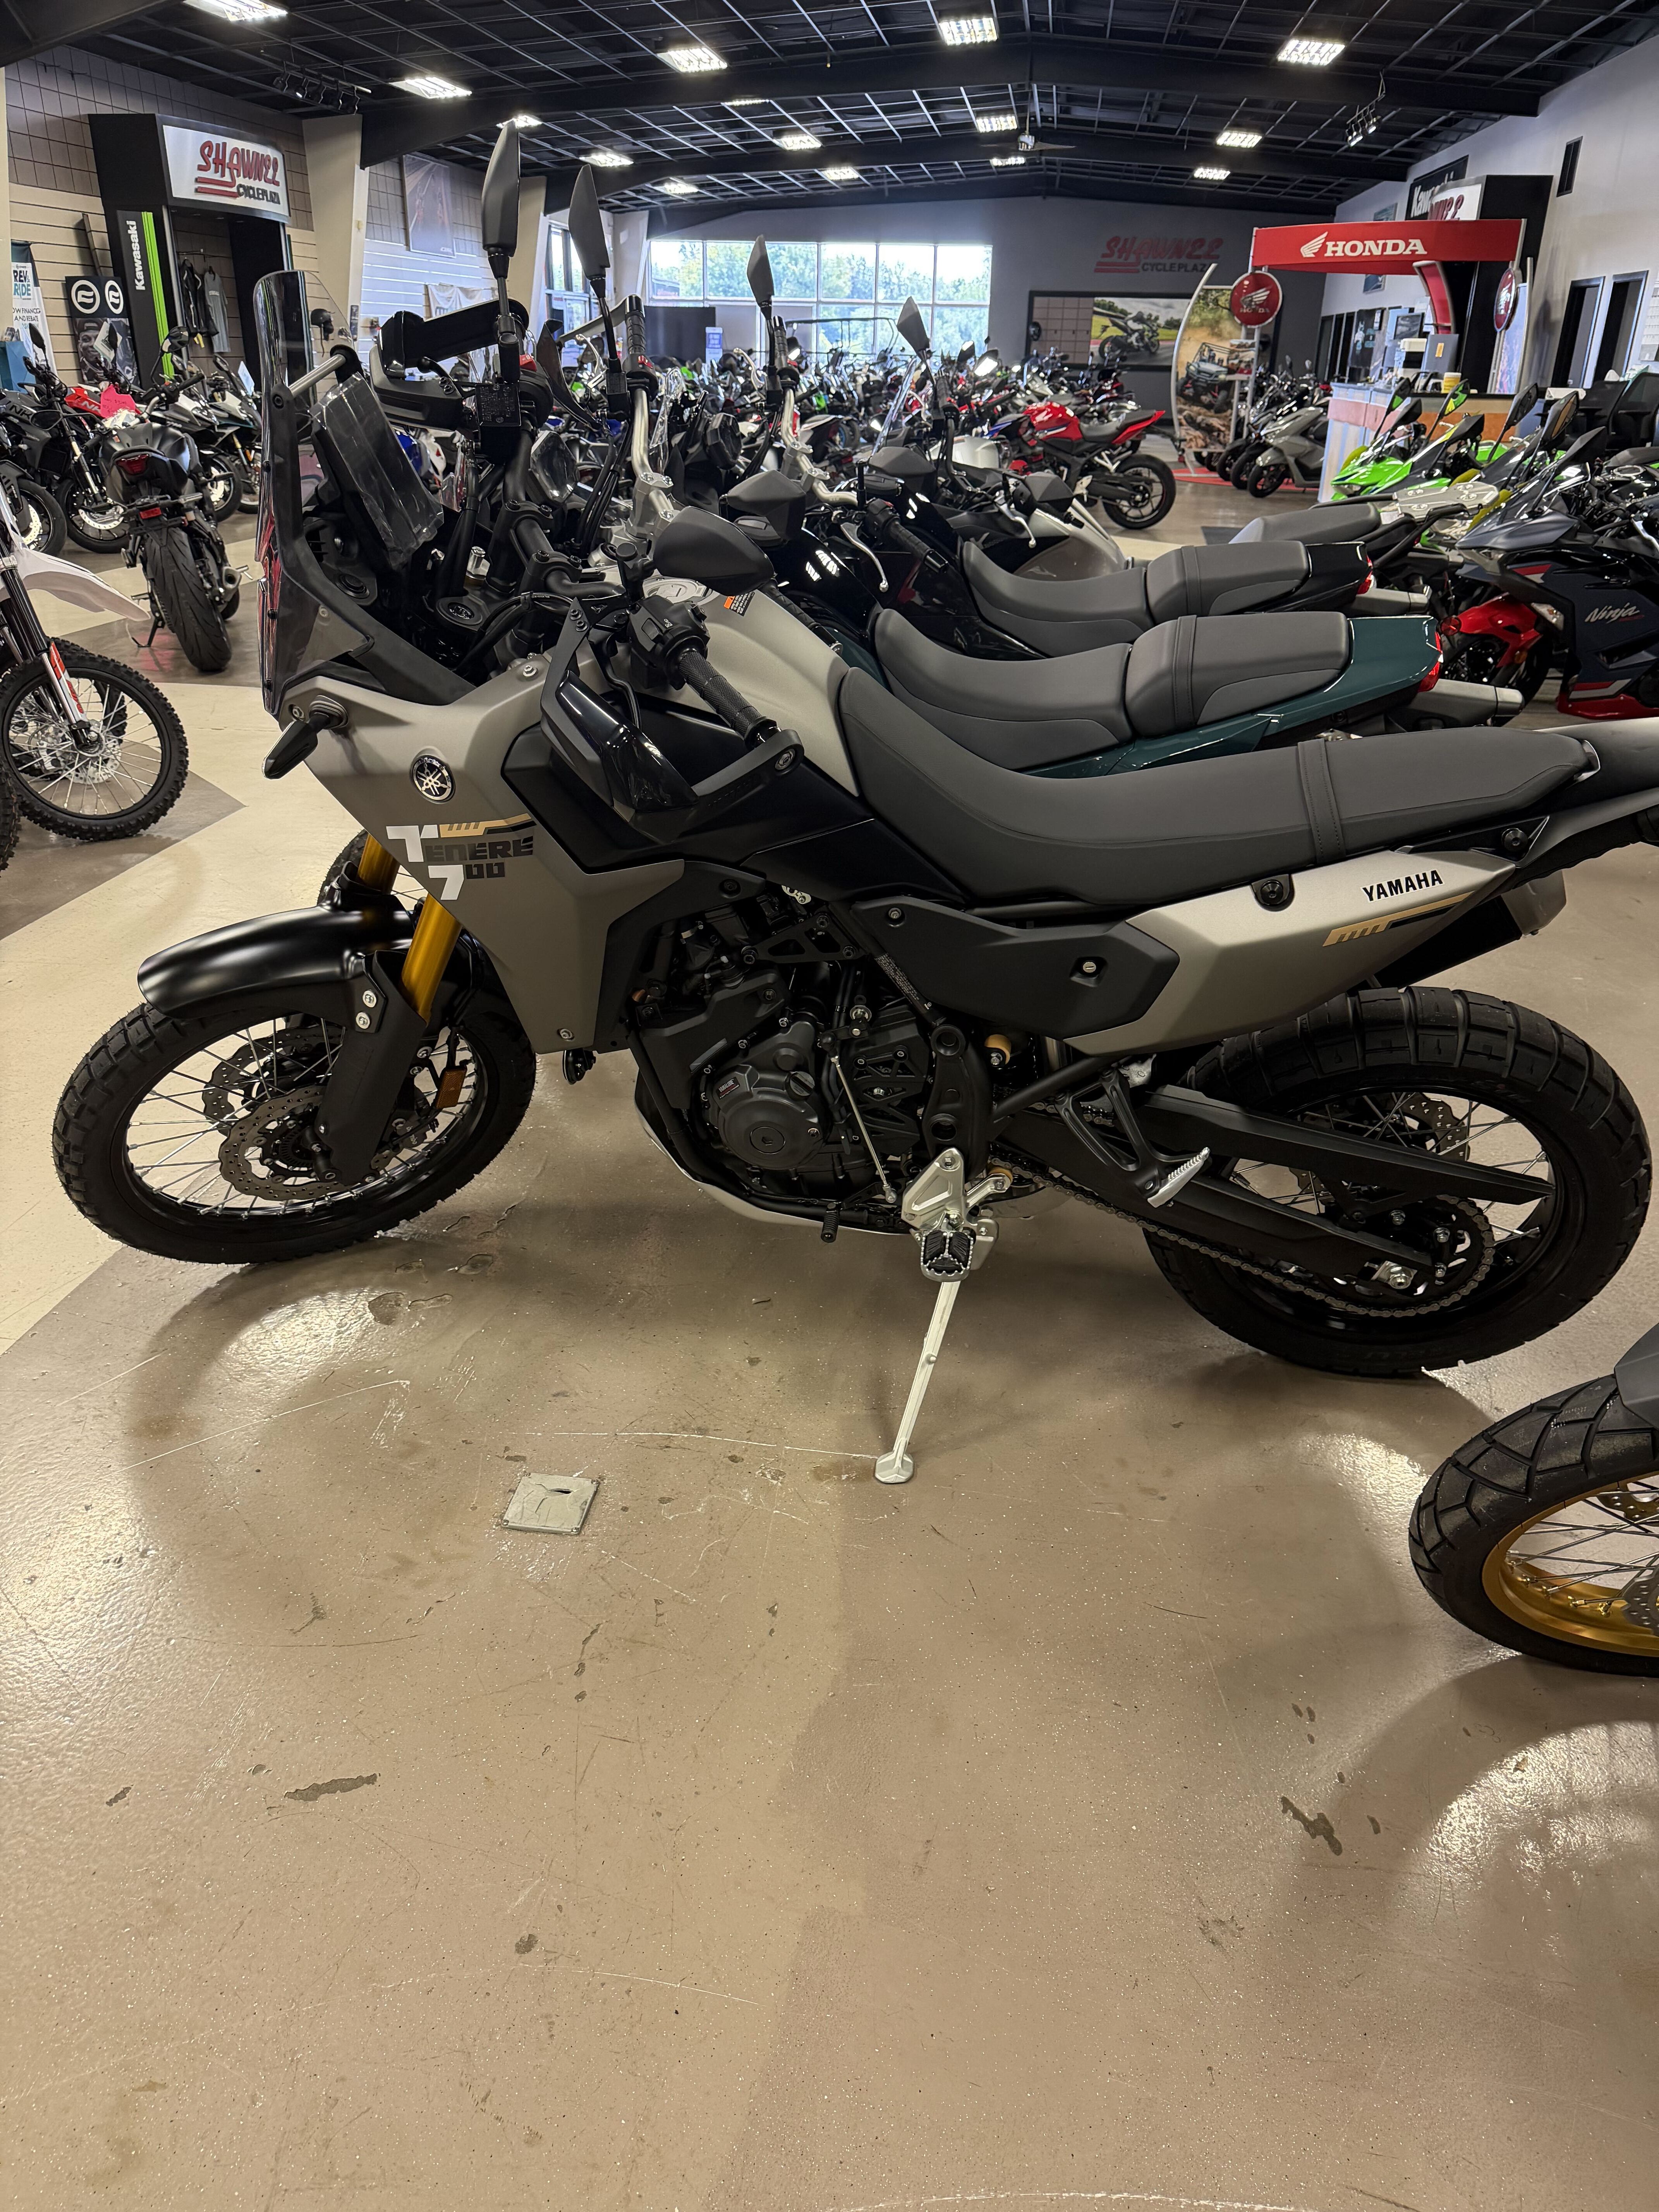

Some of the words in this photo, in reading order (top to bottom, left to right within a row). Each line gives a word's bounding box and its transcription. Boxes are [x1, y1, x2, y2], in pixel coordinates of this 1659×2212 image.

[197, 140, 280, 187] SHAWNEE
[126, 220, 146, 290] Kawasaki
[1101, 235, 1224, 261] SHAWNEE
[1324, 239, 1427, 256] HONDA
[13, 270, 27, 283] REV
[1142, 263, 1209, 272] CYCLEPLAZ
[13, 283, 31, 297] RIDE
[1584, 602, 1640, 623] Ninja
[428, 862, 505, 900] 700
[1362, 870, 1443, 902] YAMAHA
